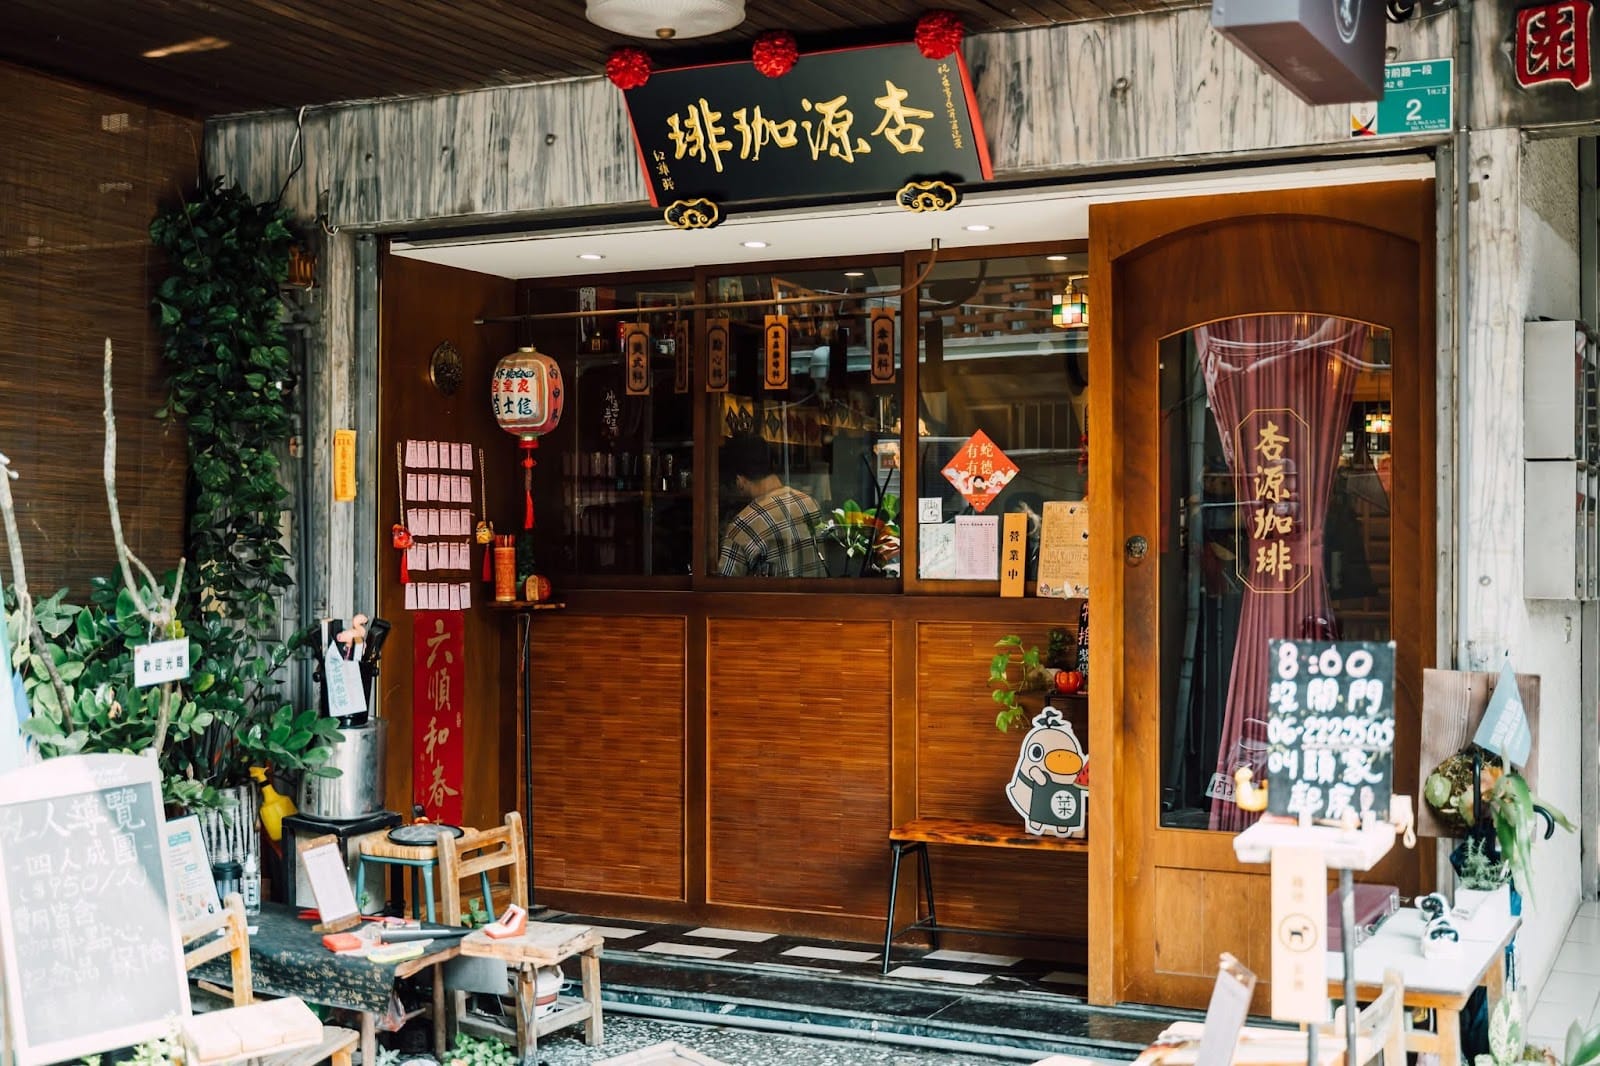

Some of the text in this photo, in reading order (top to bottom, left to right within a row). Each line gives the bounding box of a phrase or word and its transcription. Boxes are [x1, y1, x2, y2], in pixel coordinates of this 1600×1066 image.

[667, 80, 934, 173] 杏源珈琲
[1406, 98, 1422, 121] 2
[1253, 420, 1293, 581] 杏源珈琲
[1008, 530, 1020, 580] 營業中
[1278, 642, 1374, 681] 8:00
[1056, 795, 1073, 817] 菜
